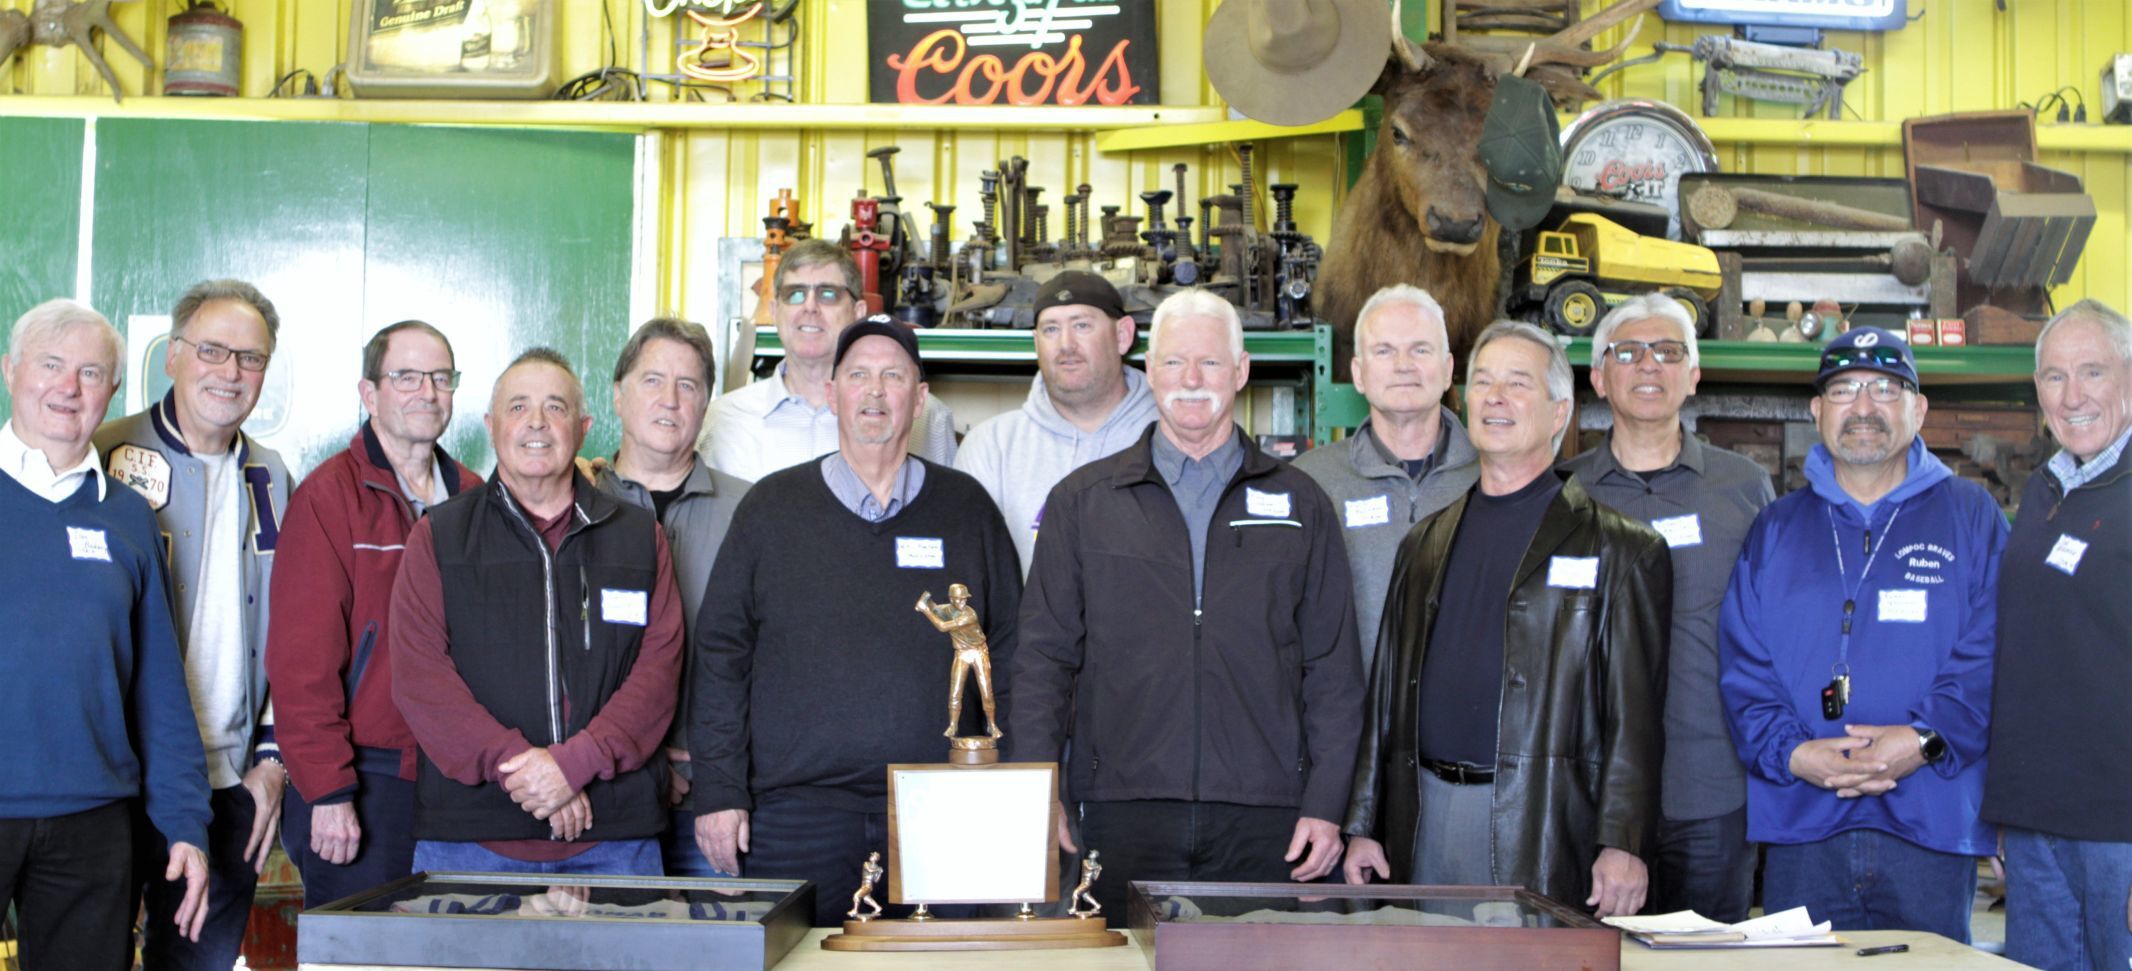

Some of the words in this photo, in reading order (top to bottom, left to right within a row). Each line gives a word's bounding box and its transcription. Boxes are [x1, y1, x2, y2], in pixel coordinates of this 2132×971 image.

[379, 9, 431, 27] Genuine
[433, 0, 466, 18] Draft
[886, 29, 1141, 105] Coors
[1625, 124, 1644, 140] 12
[1595, 160, 1668, 191] Coors
[150, 477, 165, 493] 70
[1894, 542, 1926, 560] LOMPOC
[1927, 543, 1956, 562] BRAVES
[1909, 557, 1940, 570] Ruben
[1904, 571, 1945, 585] BASEBALL
